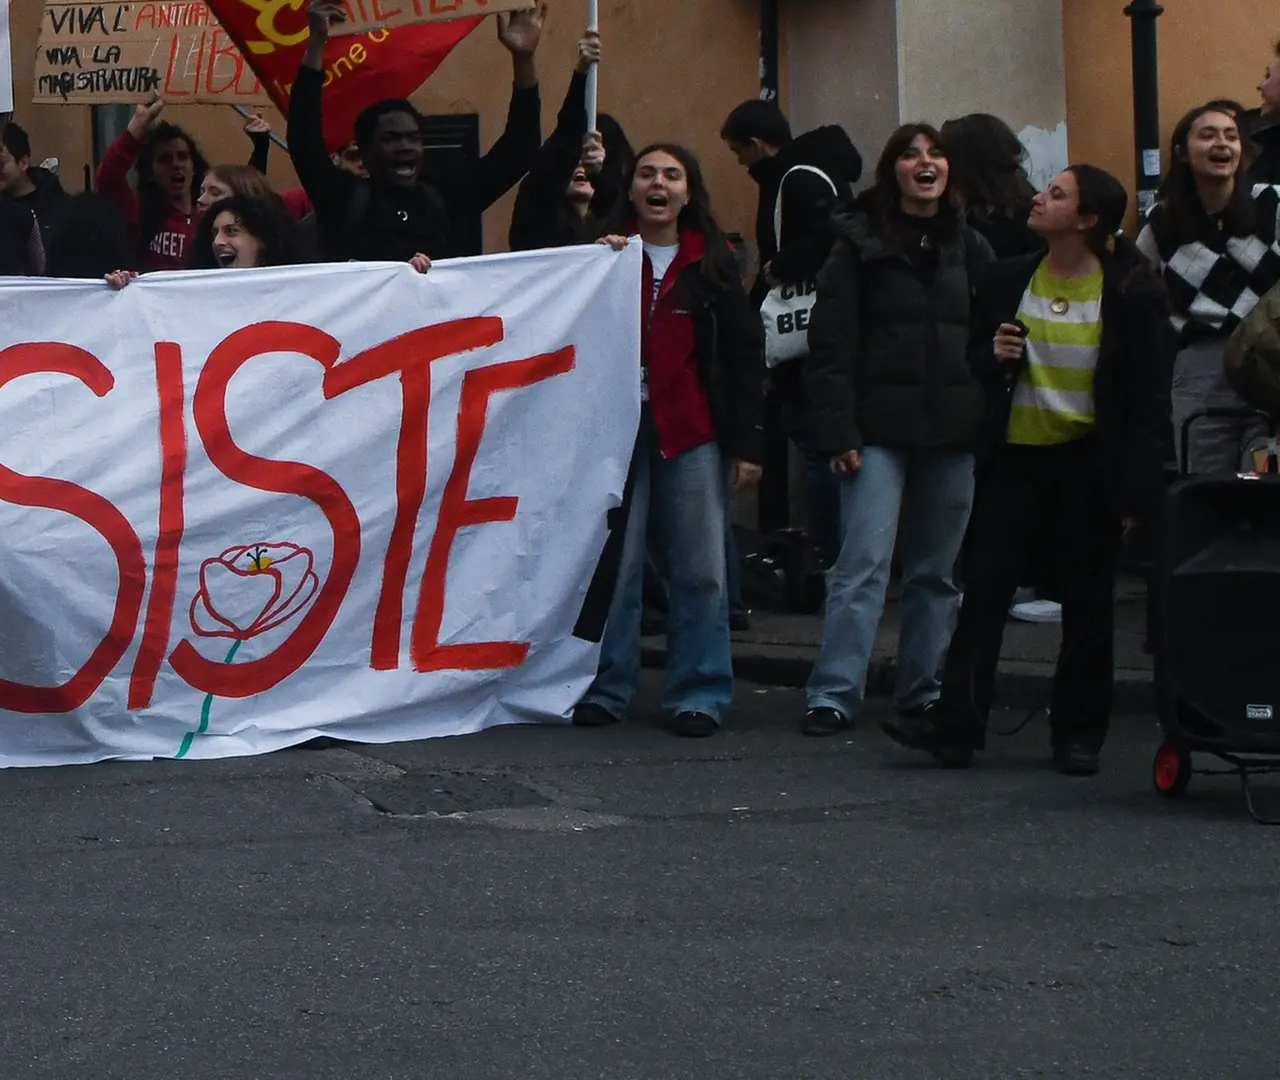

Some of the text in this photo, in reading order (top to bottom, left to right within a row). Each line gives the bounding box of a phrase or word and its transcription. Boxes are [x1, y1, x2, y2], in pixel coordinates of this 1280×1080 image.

[48, 7, 109, 35] VIVA
[45, 44, 122, 68] VIVA LA
